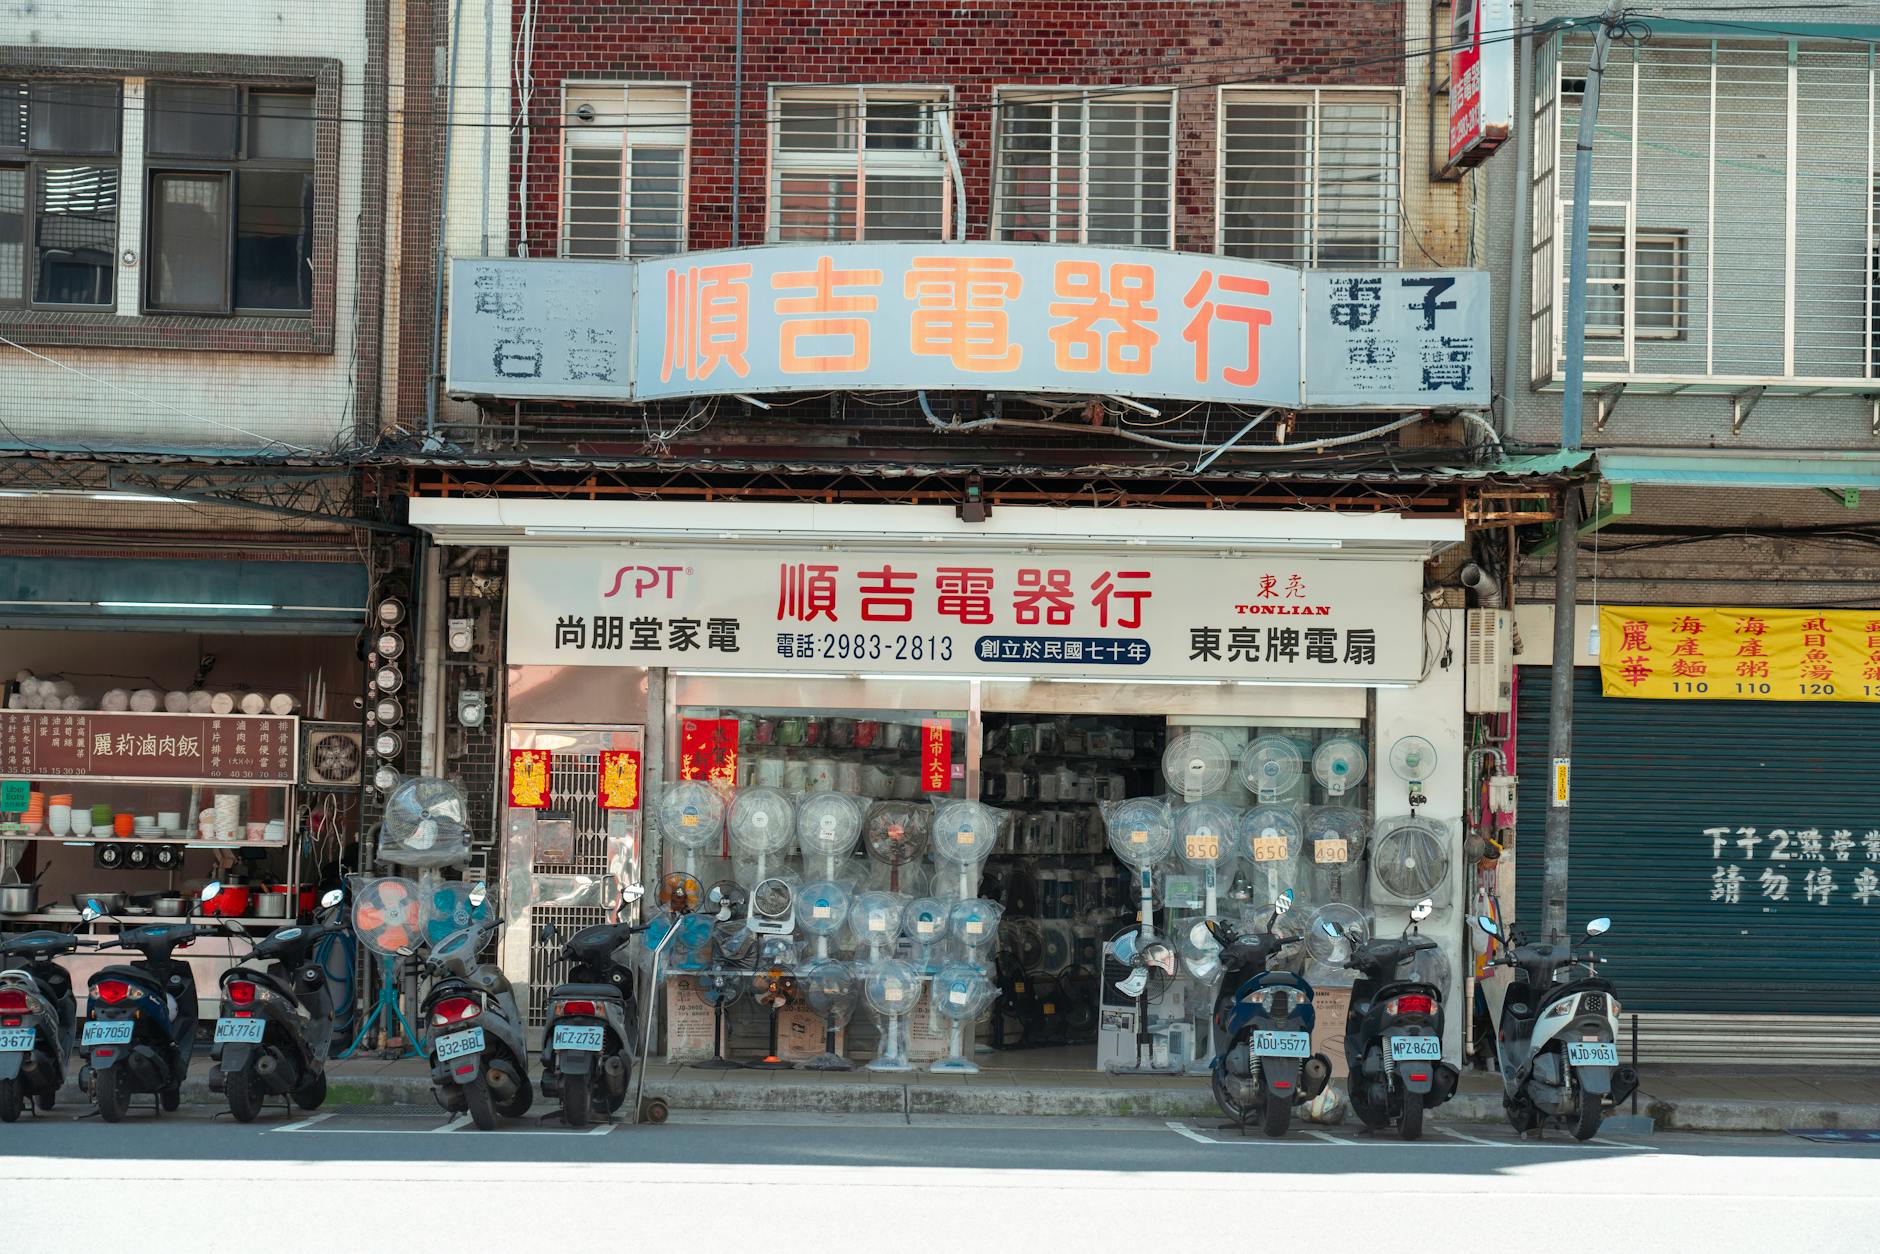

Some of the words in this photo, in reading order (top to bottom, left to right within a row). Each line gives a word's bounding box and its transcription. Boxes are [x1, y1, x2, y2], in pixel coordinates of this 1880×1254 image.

[660, 255, 1271, 388] 順吉電器行
[777, 563, 1152, 629] 順吉電器行
[1235, 604, 1331, 616] TONLIAN
[555, 615, 741, 653] 尚朋堂家電
[776, 632, 953, 661] 電話:2983-2813
[980, 639, 1147, 661] 創立於民國七十年
[1188, 626, 1376, 665] 東亮牌電扇
[1671, 615, 1706, 678] 海產麵
[1735, 616, 1770, 678] 海產粥
[1800, 617, 1835, 681] 虱目魚湯
[1618, 620, 1653, 687] 麗華
[1673, 682, 1708, 693] 110
[1735, 682, 1771, 694] 110
[1799, 683, 1835, 695] 120
[92, 732, 201, 758] 麗莉滷肉飯
[211, 719, 222, 768] 單片排骨
[235, 720, 247, 755] 滷肉飯
[258, 721, 270, 768] 滷肉便當
[278, 721, 289, 768] 排骨便當
[928, 724, 945, 789] 開市大吉
[1187, 844, 1218, 858] 850
[1255, 845, 1288, 860] 650
[1315, 847, 1346, 860] 490
[1709, 863, 1880, 906] 請勿停車
[438, 1036, 483, 1058] 932-BBL
